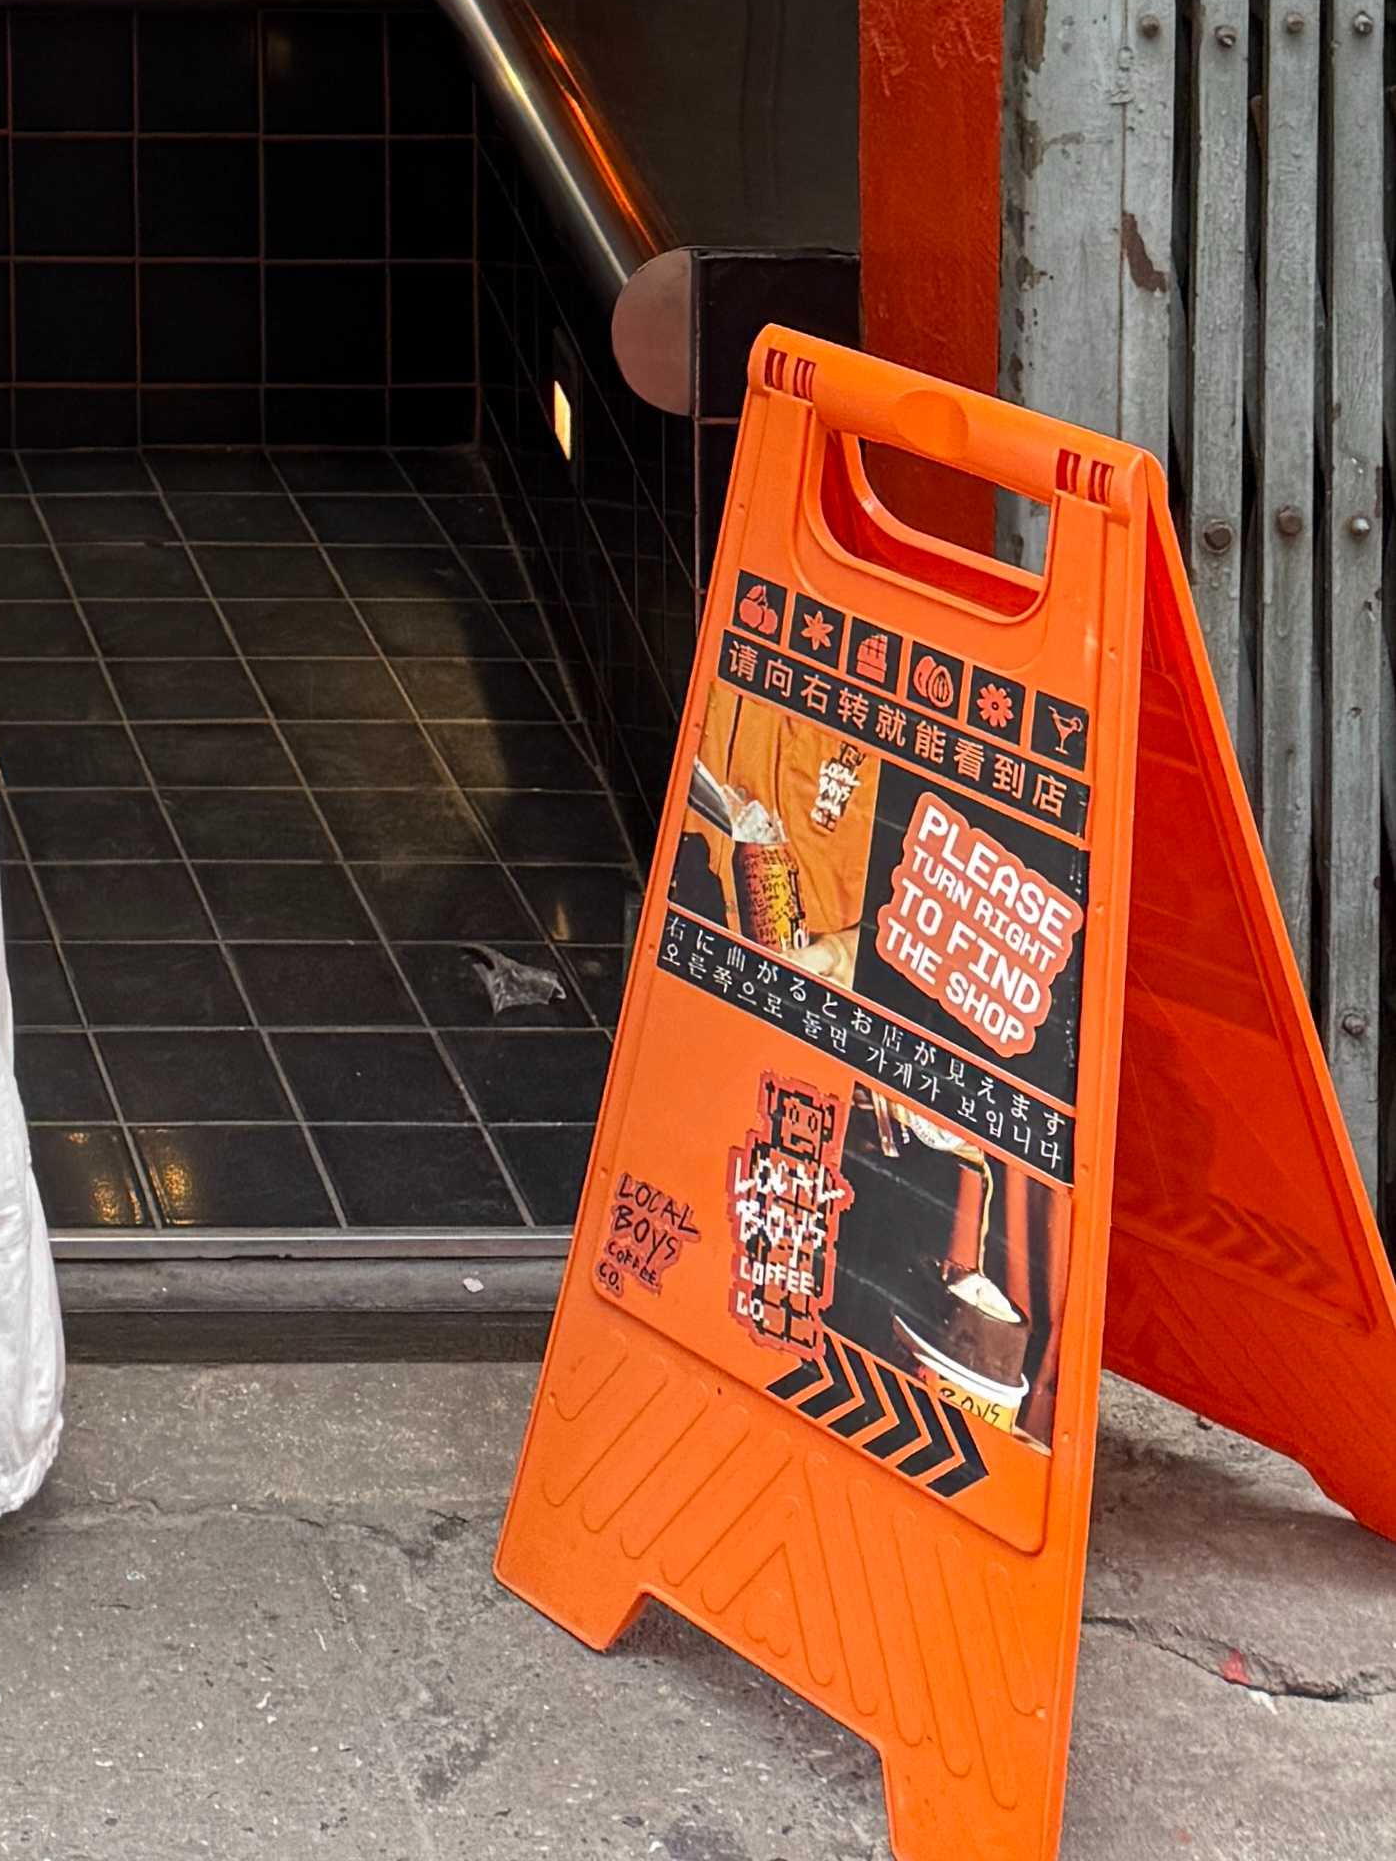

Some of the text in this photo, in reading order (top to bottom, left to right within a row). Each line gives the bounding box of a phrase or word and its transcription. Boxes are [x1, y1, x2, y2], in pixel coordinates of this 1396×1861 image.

[728, 639, 1066, 819] 请向右转就能看到店
[911, 845, 1057, 973] TURN RIGHT
[917, 805, 1072, 950] PLEASE
[886, 917, 1025, 1044] THE SHOP
[899, 877, 1042, 1014] TO FIND
[660, 943, 1062, 1170] 오른쪽으로 돌면 가게가 보입니다
[613, 1204, 678, 1265] BOYS
[617, 1172, 699, 1237] LOCAL
[734, 1156, 846, 1204] LOCAL
[735, 1198, 827, 1269] BOYS
[598, 1262, 620, 1291] CO.
